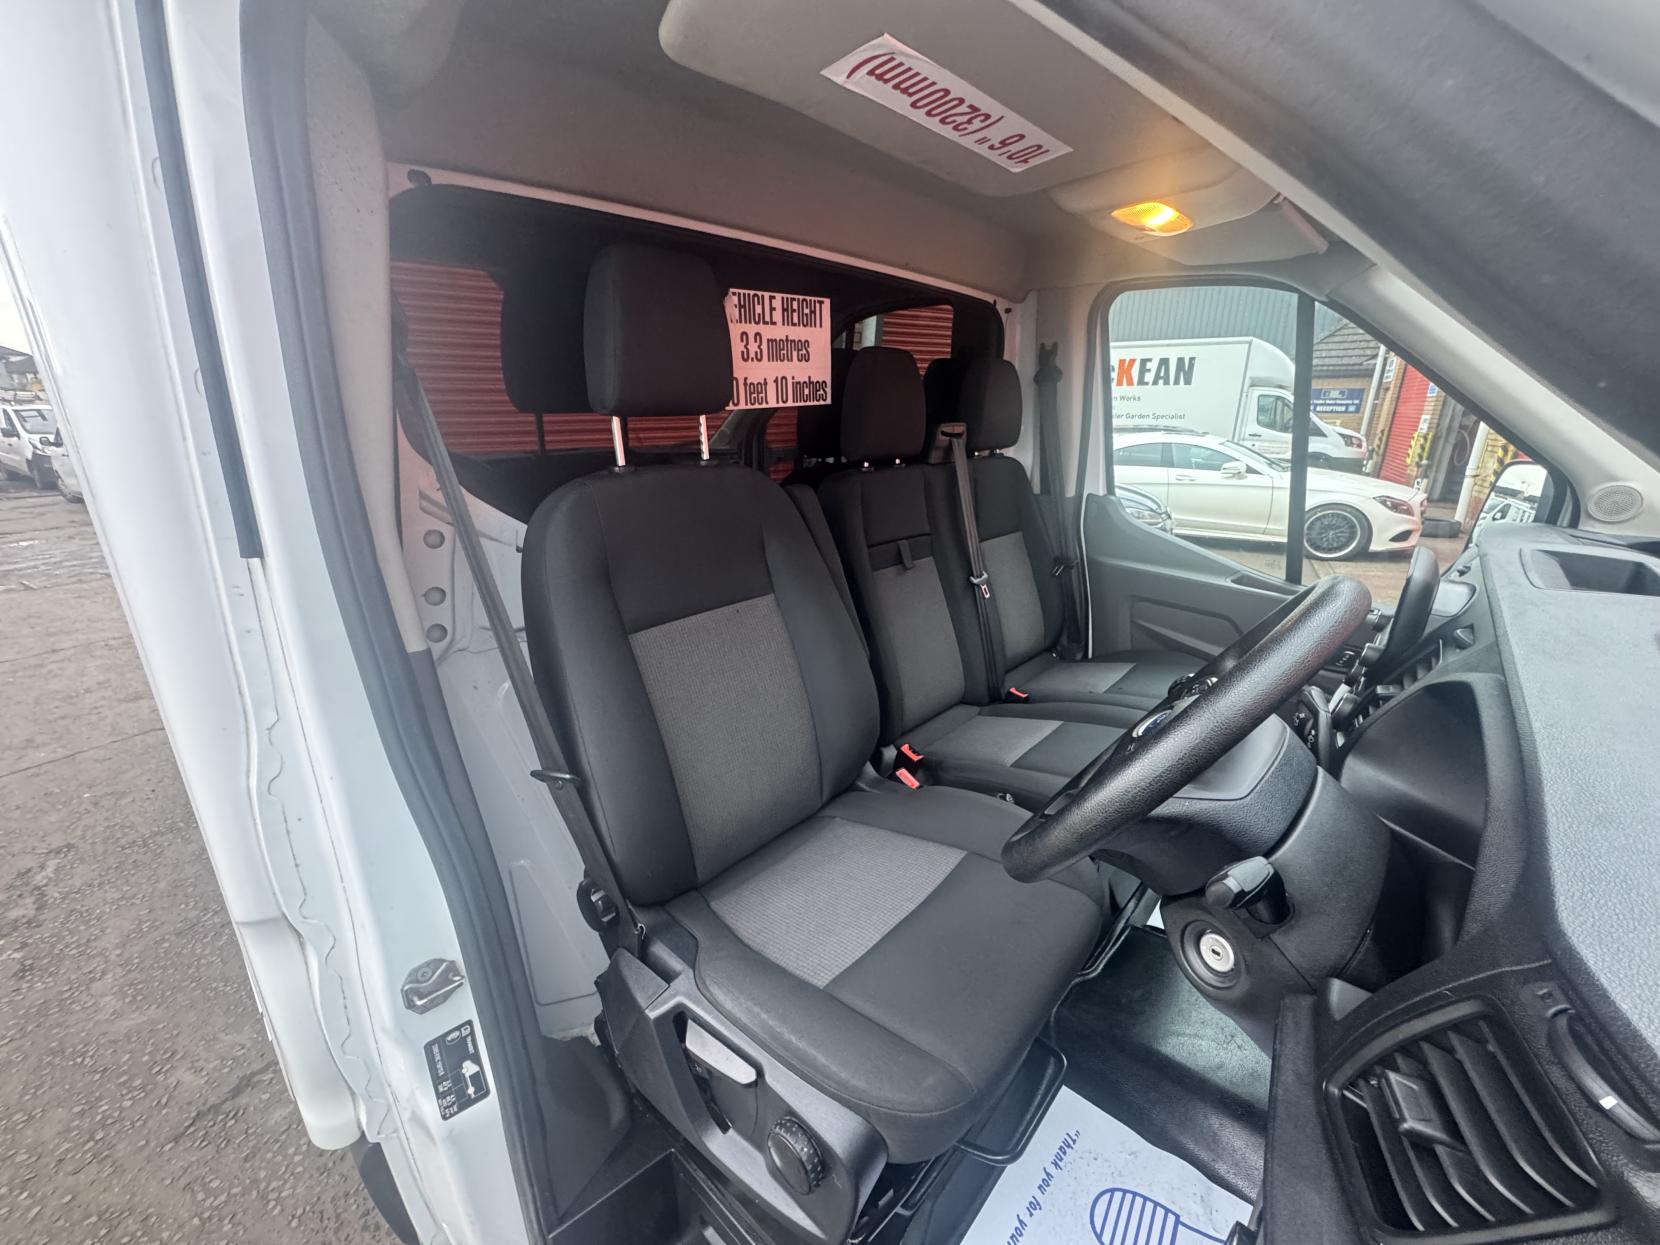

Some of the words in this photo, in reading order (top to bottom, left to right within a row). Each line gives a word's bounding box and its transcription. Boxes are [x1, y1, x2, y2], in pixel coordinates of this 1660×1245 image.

[846, 52, 1004, 137] (3200mm)
[730, 292, 777, 326] HICLE
[781, 296, 824, 328] HEIGHT
[740, 331, 763, 362] 3.3
[767, 335, 810, 363] metres
[743, 377, 768, 406] feet
[773, 376, 788, 404] 10
[792, 376, 827, 403] inches
[1037, 1166, 1055, 1195] you
[1026, 1195, 1042, 1218] for
